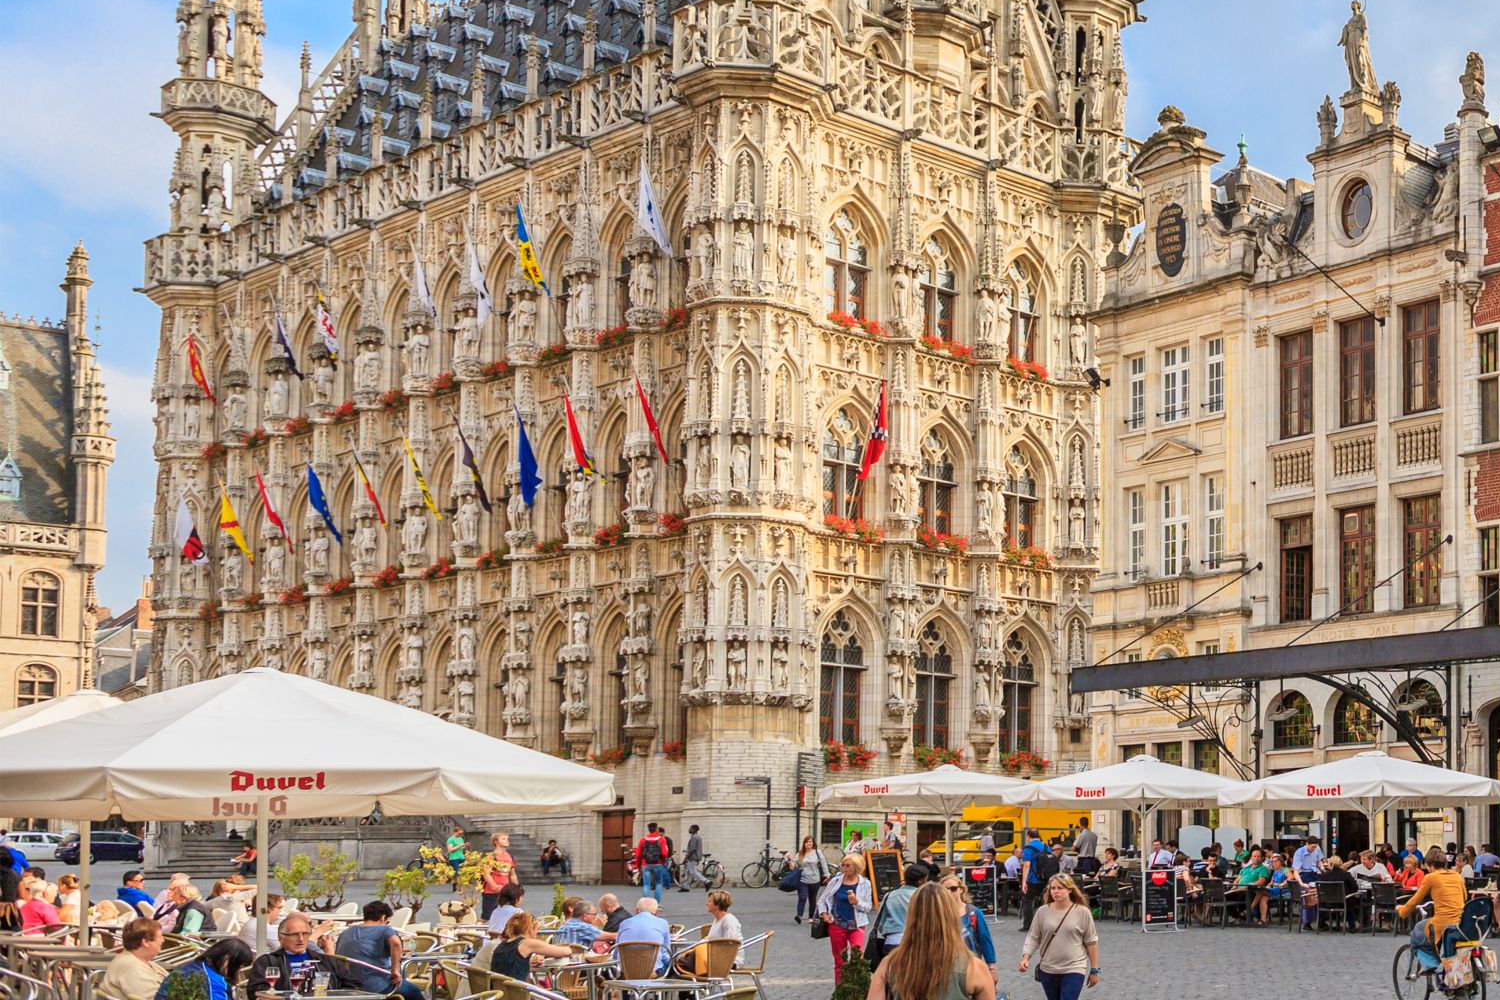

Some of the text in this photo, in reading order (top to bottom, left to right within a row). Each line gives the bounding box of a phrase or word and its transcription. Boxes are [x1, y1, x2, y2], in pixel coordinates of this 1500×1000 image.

[229, 770, 326, 792] Duvel
[863, 784, 889, 795] Duvel
[1075, 787, 1106, 798] Duvel
[1306, 784, 1342, 797] Duvel
